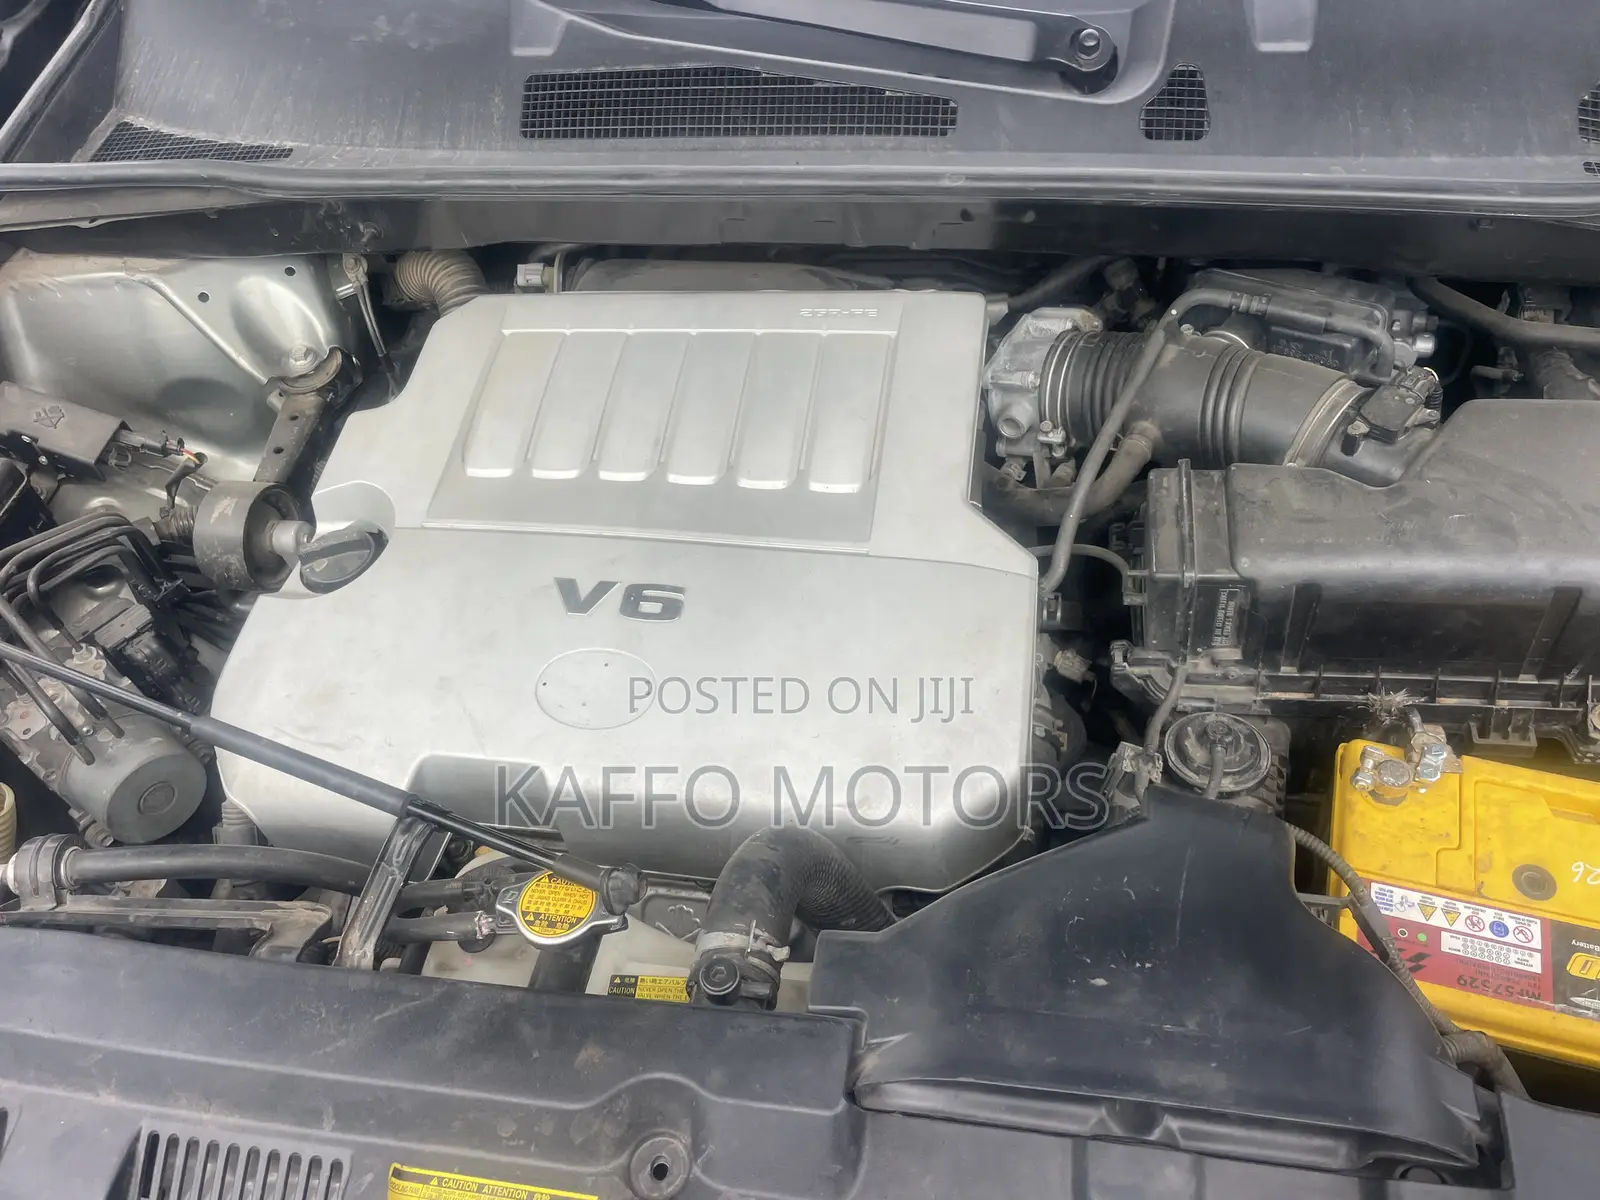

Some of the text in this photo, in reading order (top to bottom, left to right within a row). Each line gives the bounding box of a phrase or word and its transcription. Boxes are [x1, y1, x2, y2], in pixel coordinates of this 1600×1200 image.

[553, 577, 686, 622] V6
[539, 913, 577, 924] ATTENTION
[1571, 939, 1600, 952] Battery
[608, 986, 635, 994] CAUTION
[442, 1178, 479, 1193] CAUTION
[482, 1184, 529, 1200] ATTENTION
